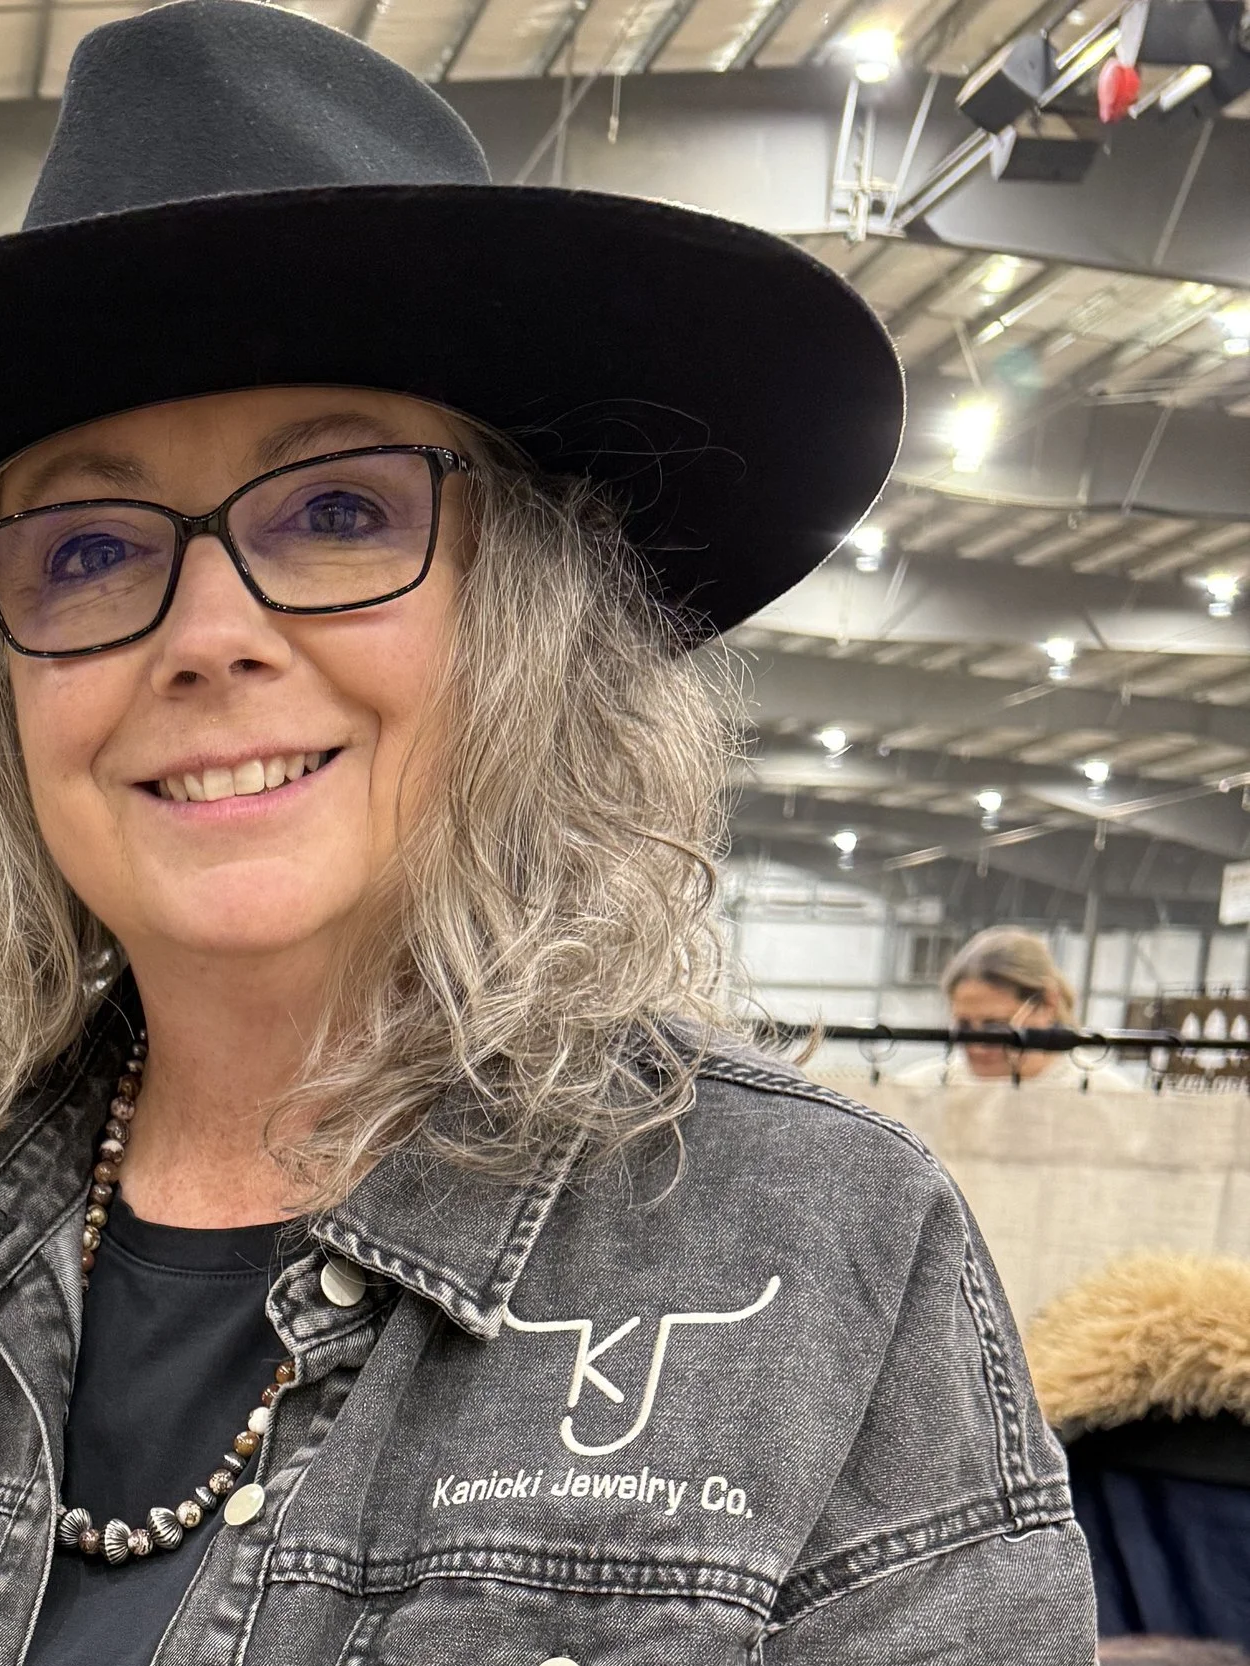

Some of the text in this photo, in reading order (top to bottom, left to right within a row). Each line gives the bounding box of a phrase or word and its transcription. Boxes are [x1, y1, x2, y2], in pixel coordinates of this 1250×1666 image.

[432, 1466, 753, 1519] Kanicki Jewelry Co.
